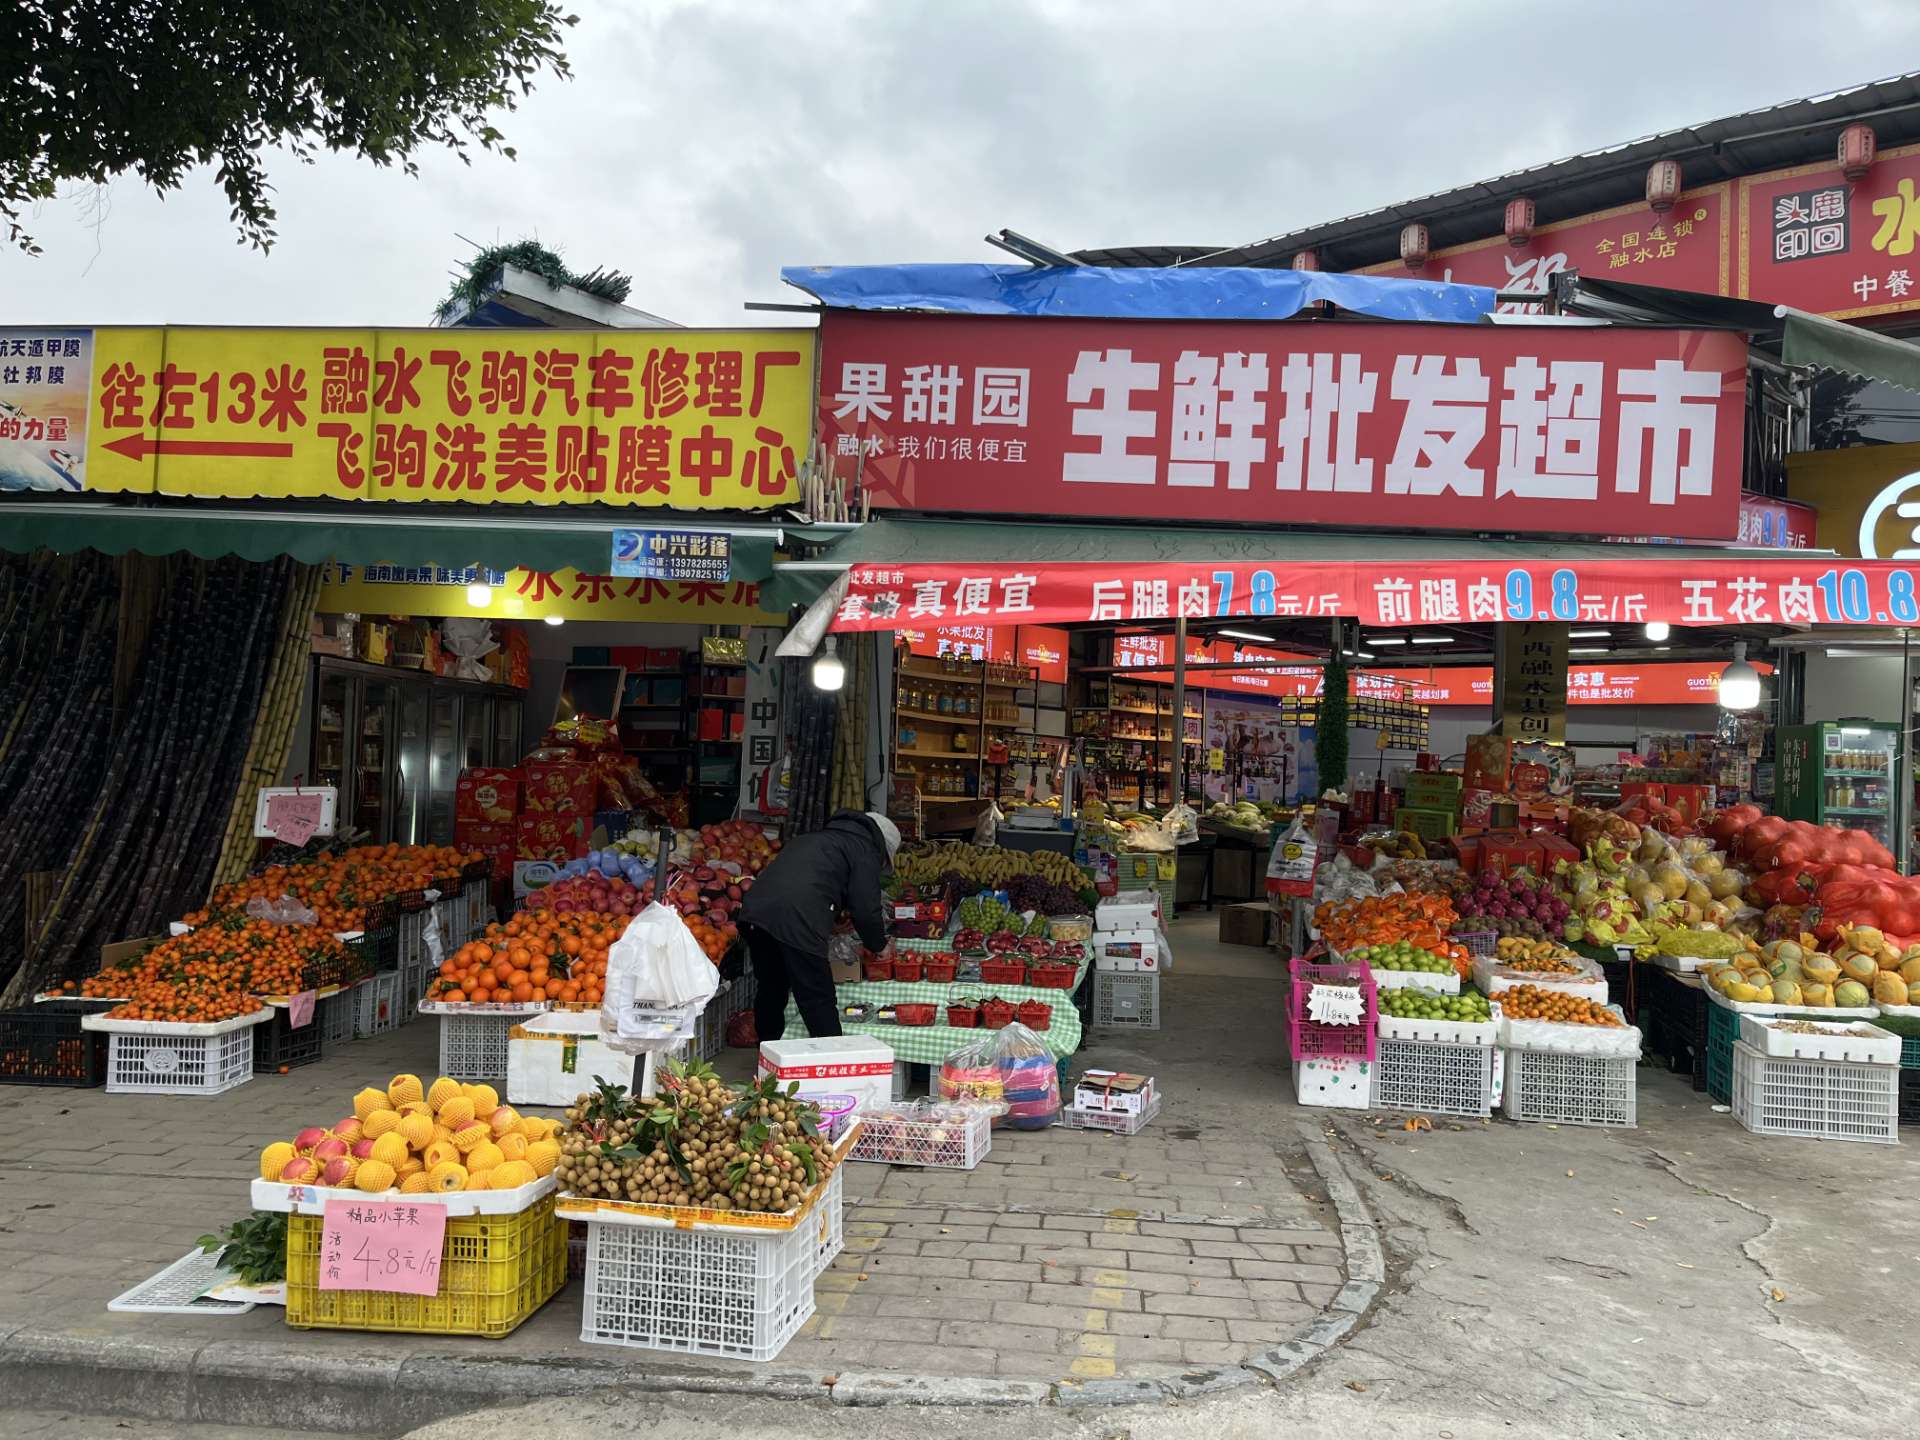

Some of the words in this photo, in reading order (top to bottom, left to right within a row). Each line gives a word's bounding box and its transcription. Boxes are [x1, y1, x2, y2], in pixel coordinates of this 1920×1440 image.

[1608, 241, 1678, 269] 融水店
[100, 361, 308, 433] 往左13米
[320, 346, 802, 420] 融水飞驹汽车修理厂
[832, 361, 1031, 428] 果甜园
[0, 417, 68, 441] 的力量
[837, 433, 885, 457] 融水
[898, 434, 1028, 464] 我们很便宜
[1062, 348, 1722, 505] 生鲜批发超市
[316, 422, 797, 497] 飞驹洗美贴膜中心
[907, 573, 1038, 619] 真便宜
[346, 1206, 421, 1232] 精品小苹果
[351, 1236, 438, 1282] 4.8元/斤
